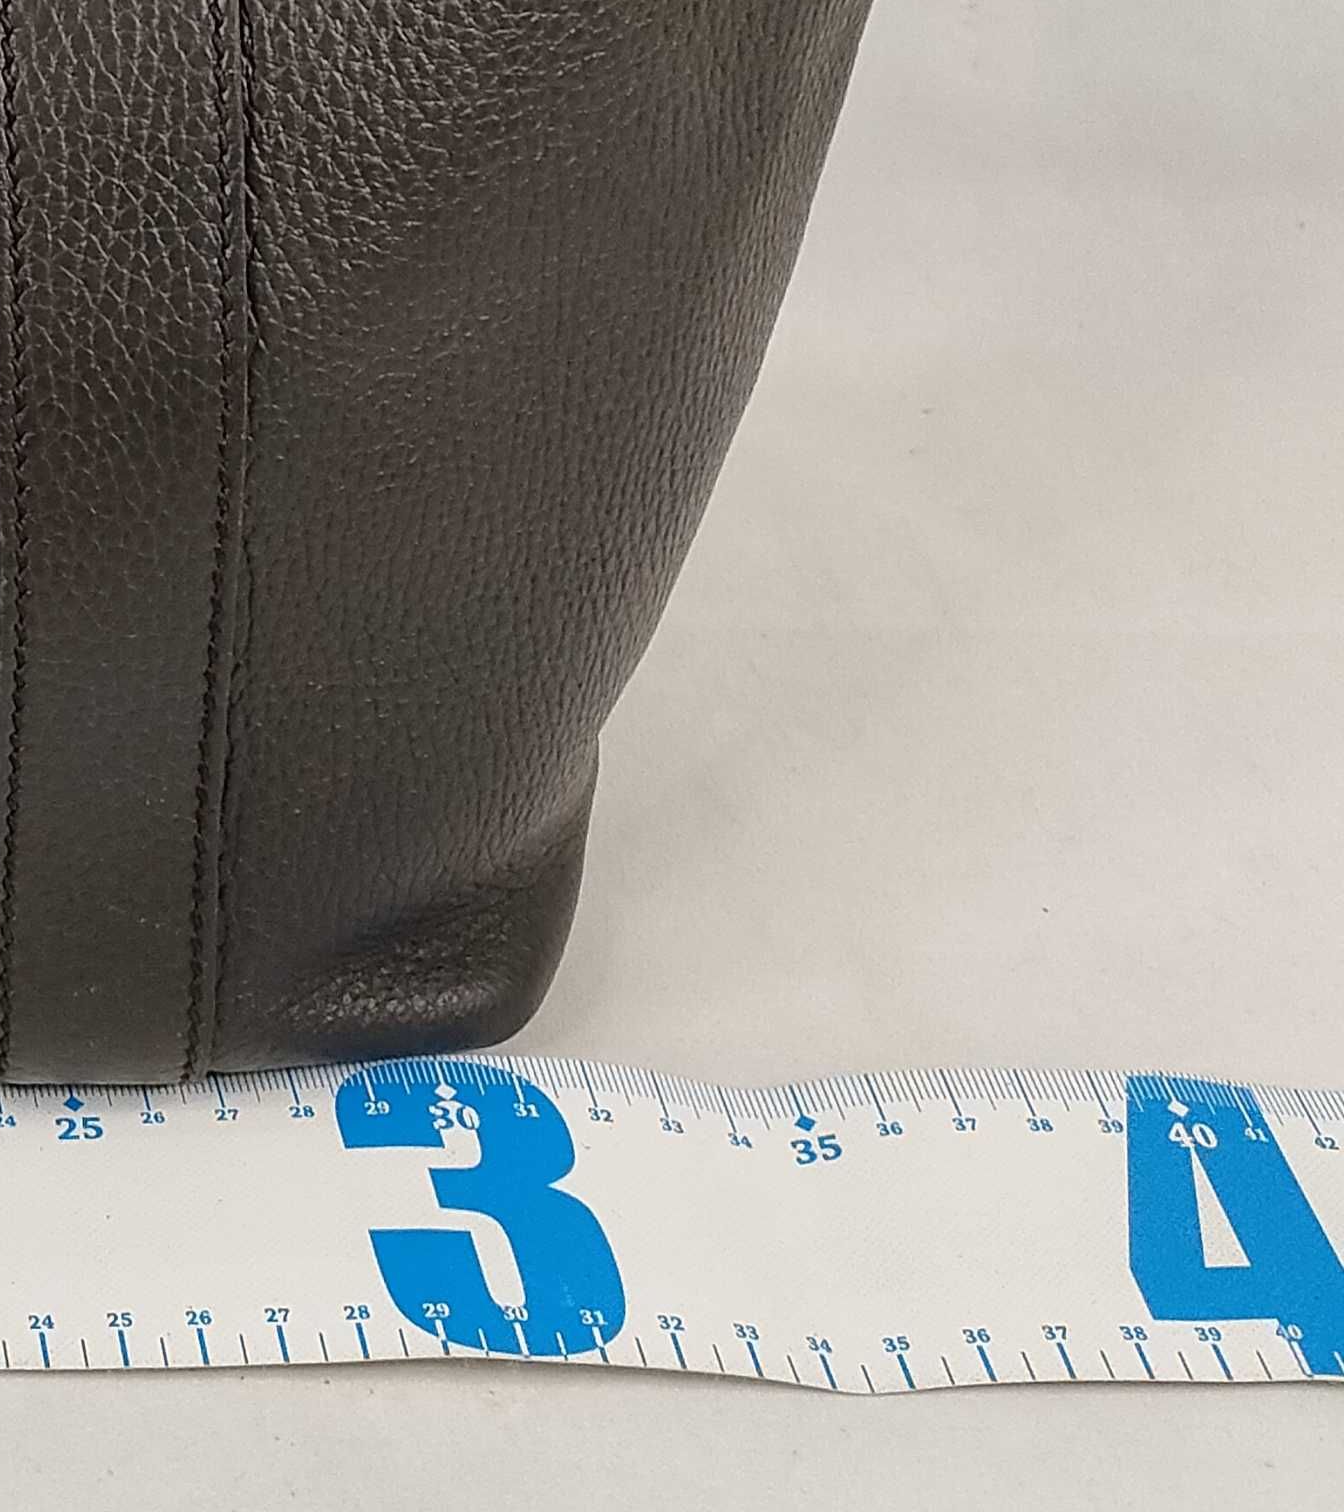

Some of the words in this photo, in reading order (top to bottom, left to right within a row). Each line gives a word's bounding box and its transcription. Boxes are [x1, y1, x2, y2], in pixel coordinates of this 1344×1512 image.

[55, 1117, 104, 1140] 25
[140, 1111, 165, 1124] 26
[214, 1109, 240, 1121] 27
[288, 1105, 315, 1118] 28
[364, 1101, 390, 1116] 29
[428, 1104, 481, 1131] 30
[513, 1102, 541, 1118] 31
[588, 1108, 614, 1123] 32
[660, 1117, 685, 1134] 33
[728, 1133, 753, 1149] 34
[790, 1134, 843, 1165] 35
[876, 1121, 904, 1137] 36
[952, 1117, 977, 1131] 37
[1026, 1117, 1054, 1133] 38
[1098, 1119, 1123, 1134] 39
[1168, 1122, 1218, 1149] 40
[1244, 1127, 1269, 1143] 41
[1315, 1136, 1339, 1151] 42
[334, 1058, 626, 1357] 3
[1125, 1074, 1344, 1379] 4
[28, 1315, 55, 1329] 24
[107, 1313, 133, 1327] 25
[185, 1310, 212, 1325] 26
[264, 1308, 290, 1322] 27
[343, 1305, 370, 1320] 28
[422, 1303, 450, 1318] 29
[502, 1306, 529, 1322] 30
[579, 1309, 608, 1326] 31
[657, 1315, 685, 1330] 32
[733, 1323, 759, 1339] 33
[806, 1337, 833, 1354] 34
[882, 1336, 910, 1353] 35
[962, 1328, 991, 1344] 36
[1042, 1325, 1067, 1341] 37
[1119, 1326, 1148, 1340] 38
[1194, 1327, 1221, 1341] 39
